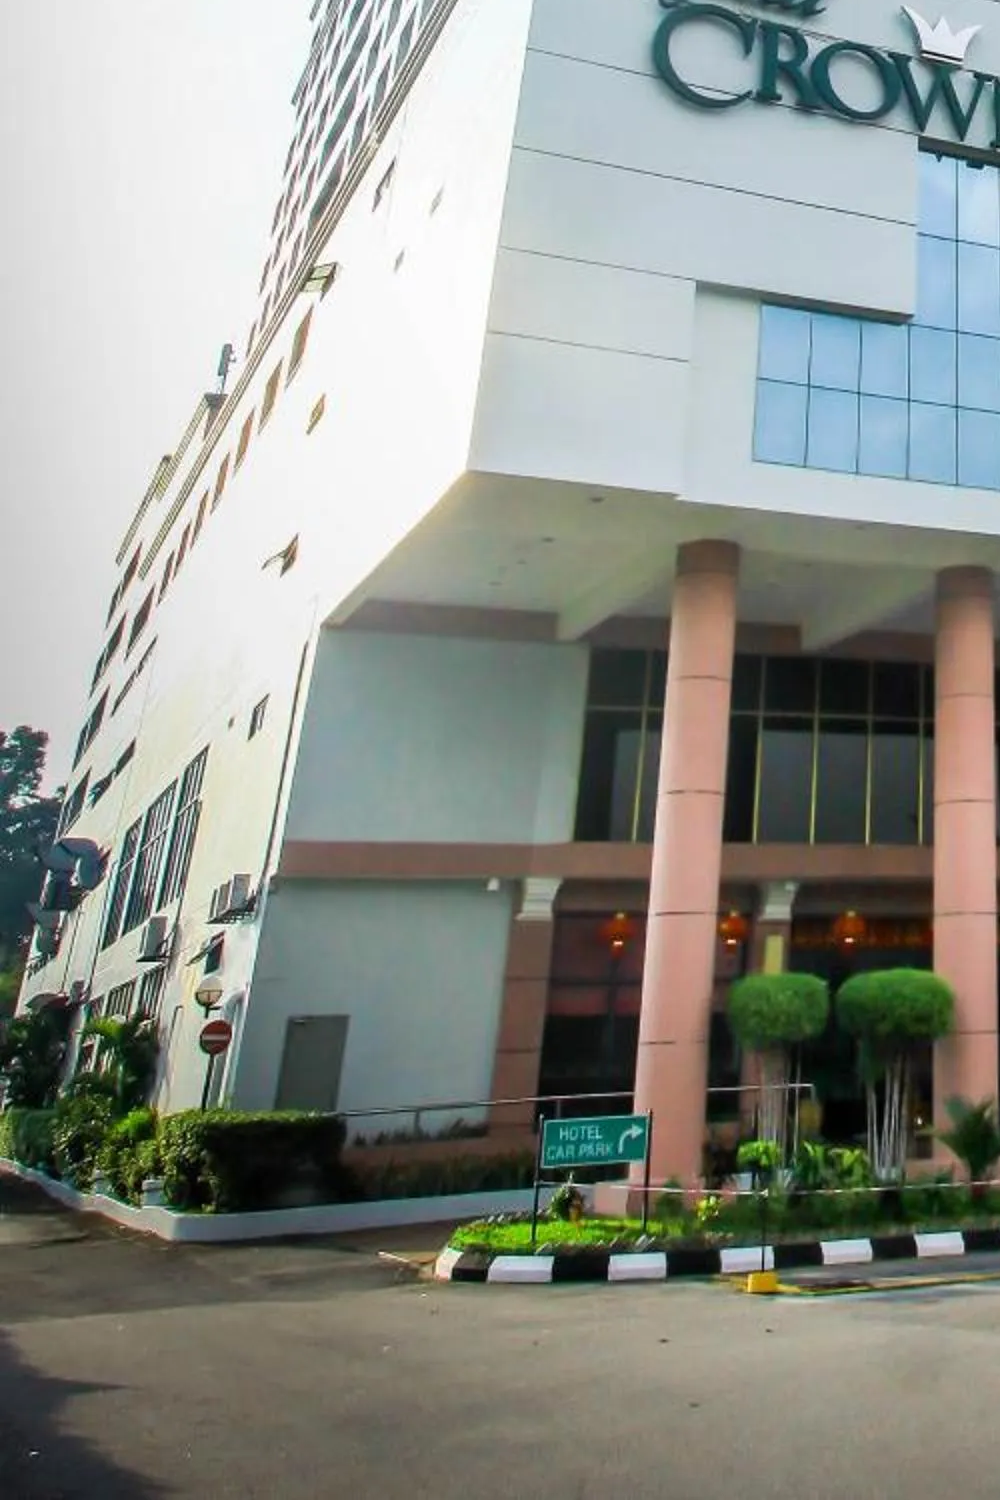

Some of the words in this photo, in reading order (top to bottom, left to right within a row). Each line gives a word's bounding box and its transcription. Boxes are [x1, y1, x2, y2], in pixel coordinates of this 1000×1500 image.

[559, 1124, 602, 1141] HOTEL
[547, 1143, 575, 1160] CAR
[578, 1142, 614, 1157] PARK
